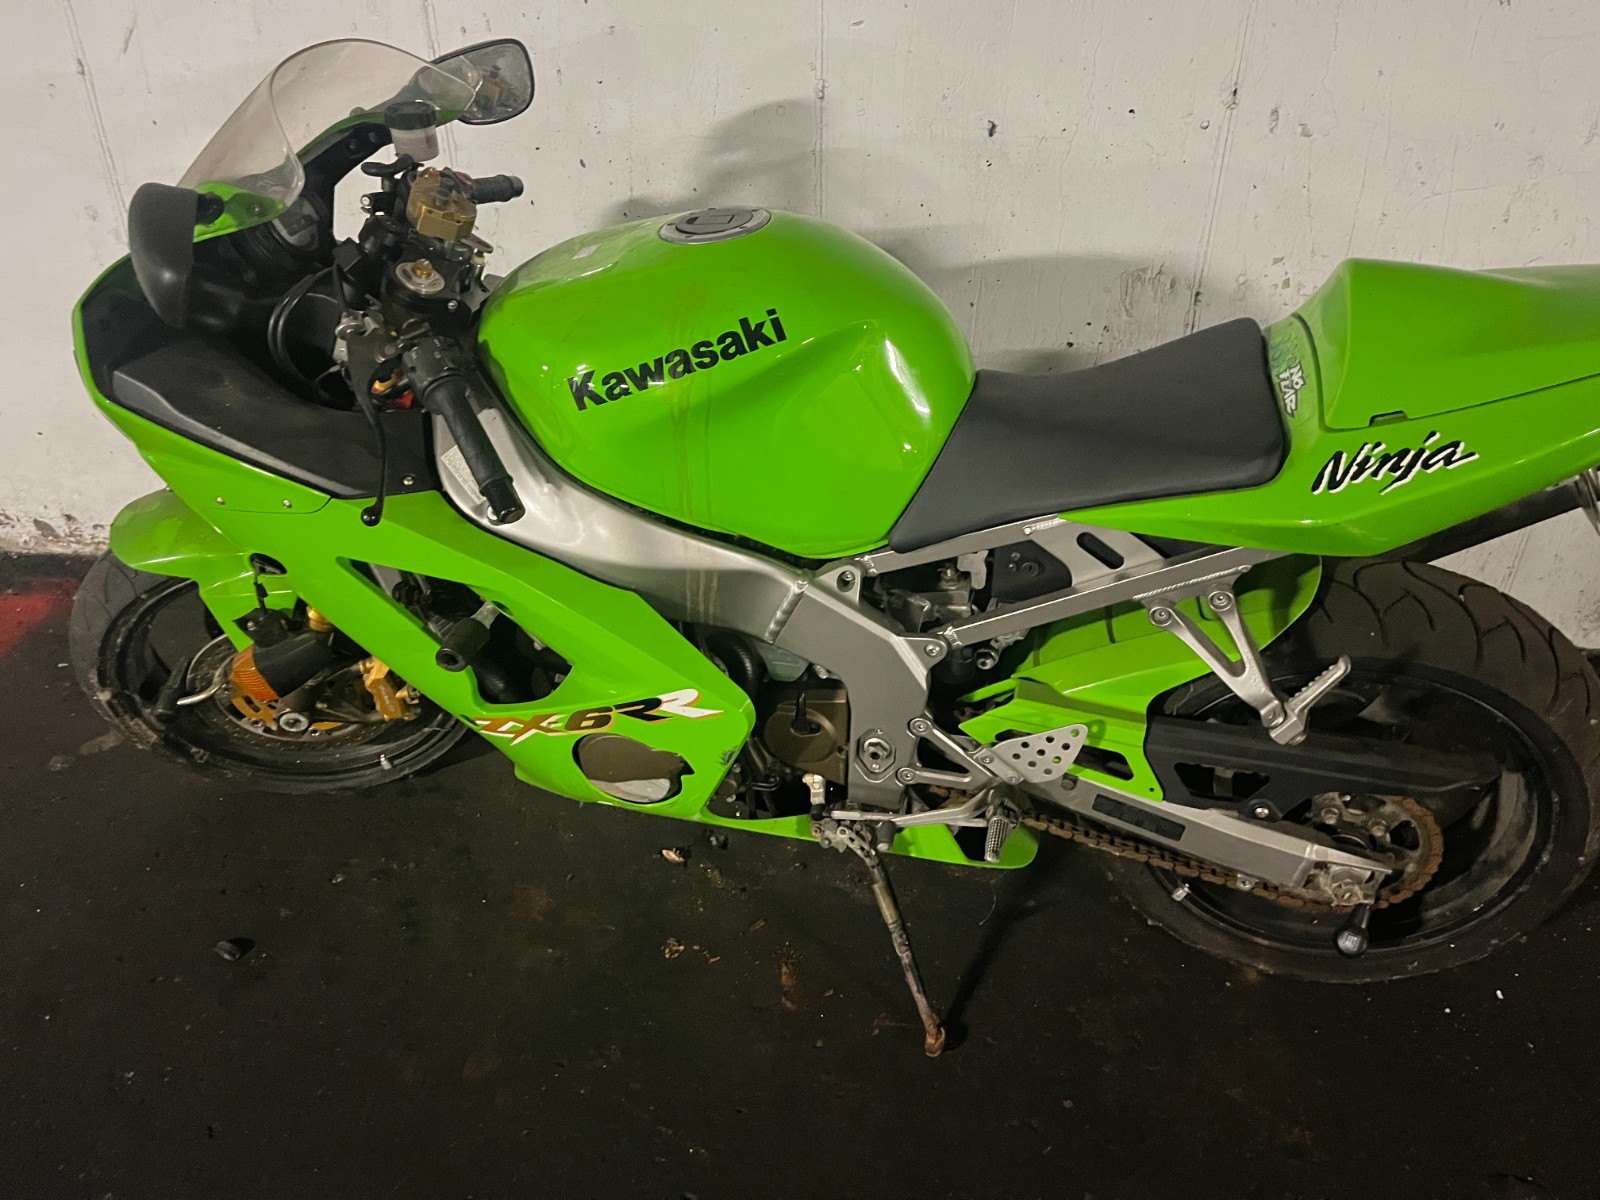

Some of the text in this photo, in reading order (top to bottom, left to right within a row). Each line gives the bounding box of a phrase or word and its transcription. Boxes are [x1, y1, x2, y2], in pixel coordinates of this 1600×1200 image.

[567, 309, 788, 411] Kawasaki
[1289, 363, 1305, 389] NO
[1279, 369, 1297, 415] FEAR
[1312, 430, 1479, 495] Ninja
